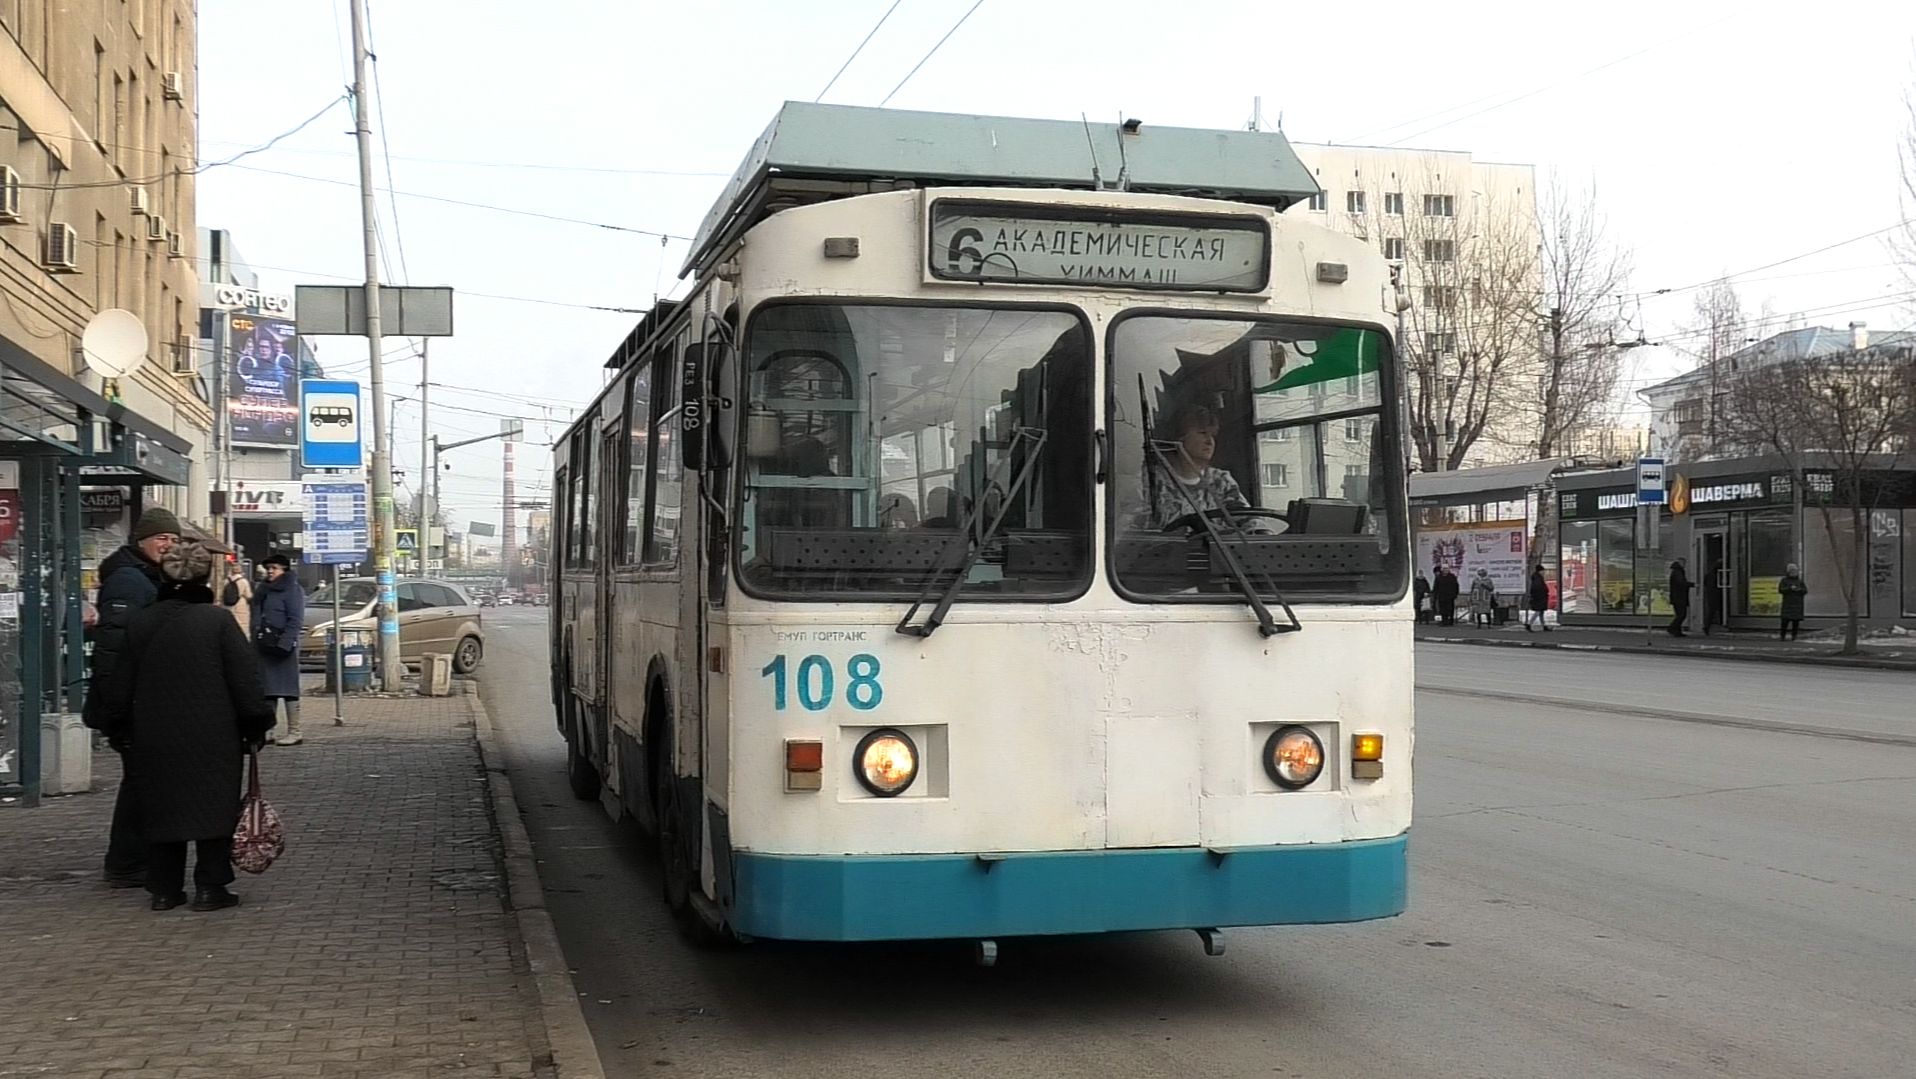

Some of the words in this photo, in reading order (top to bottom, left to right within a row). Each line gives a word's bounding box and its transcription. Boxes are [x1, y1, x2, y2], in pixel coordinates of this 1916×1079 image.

[948, 227, 984, 274] 6
[994, 227, 1226, 262] АКАДЕМИЧЕСКАЯ
[683, 398, 700, 431] 108
[1598, 490, 1668, 510] ШАШЛ
[1690, 482, 1764, 504] ШАВЕРМА
[762, 653, 884, 711] 108
